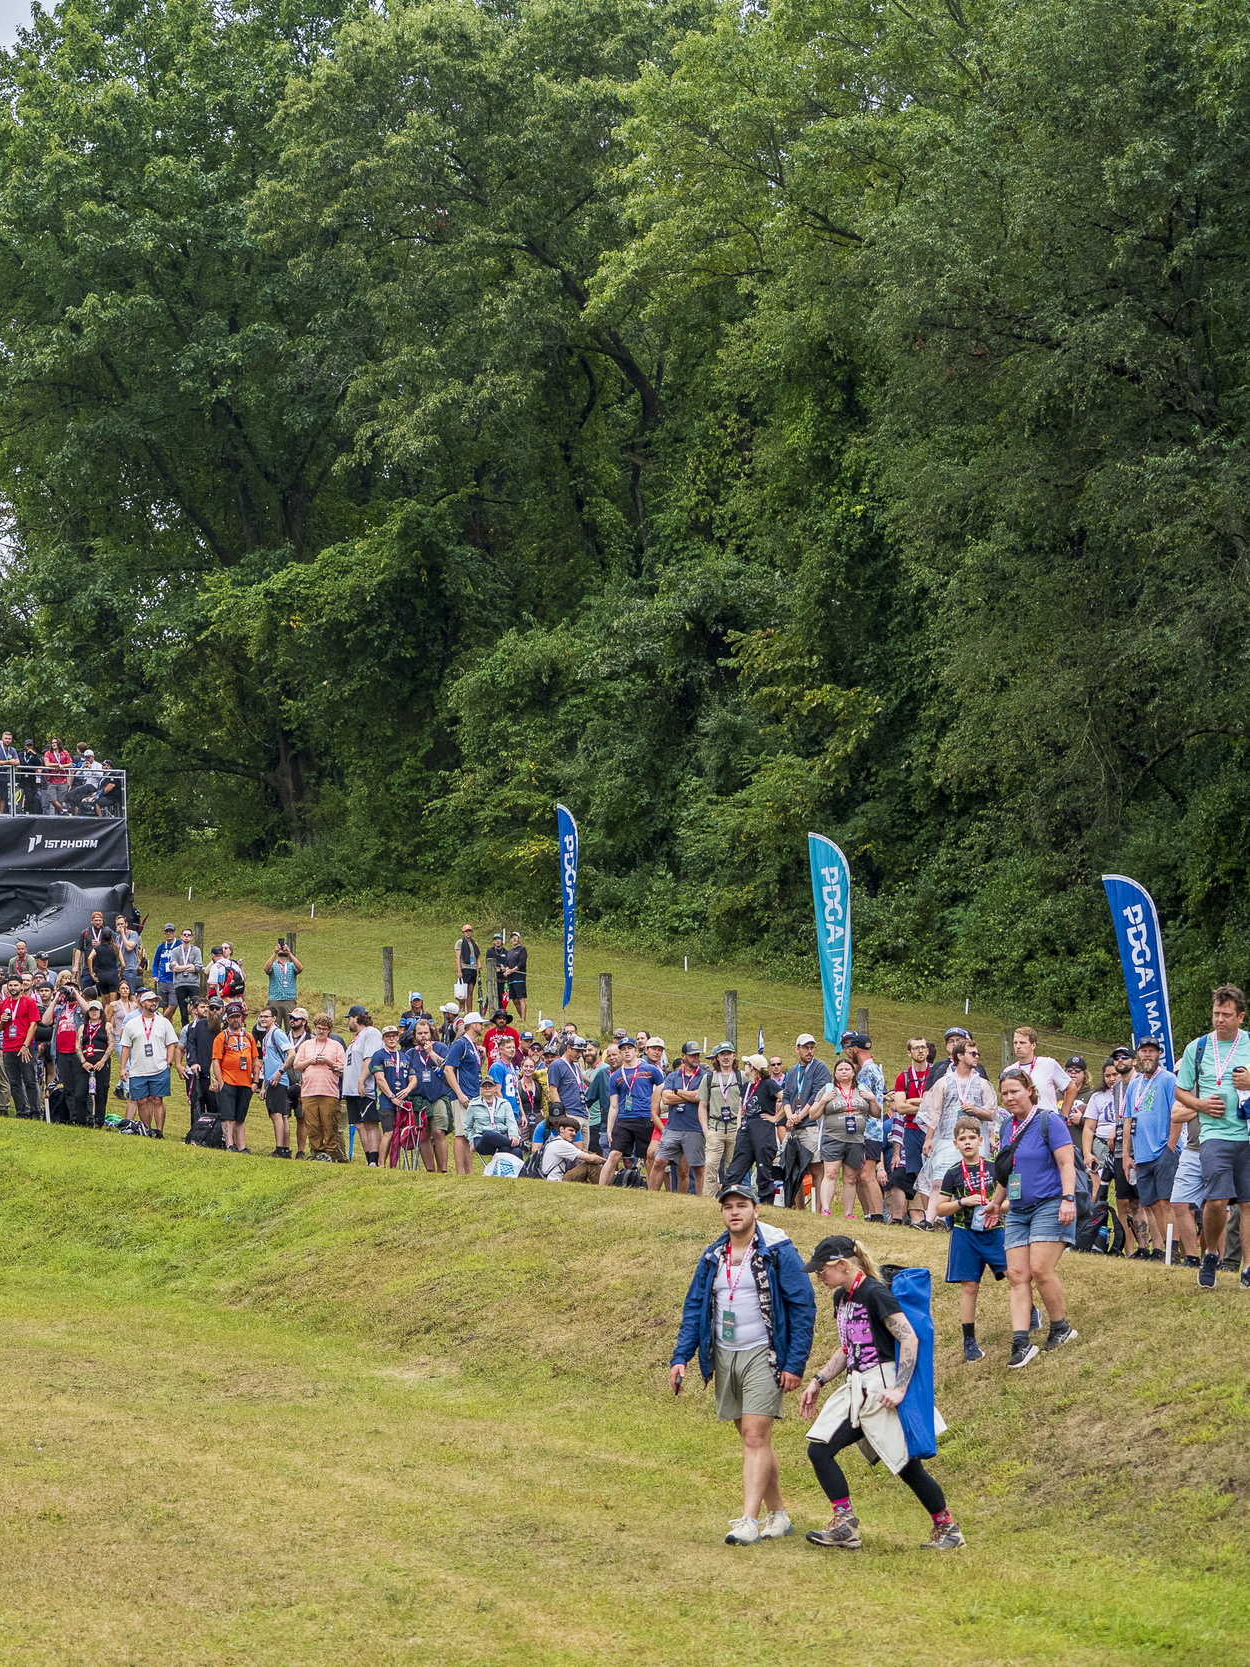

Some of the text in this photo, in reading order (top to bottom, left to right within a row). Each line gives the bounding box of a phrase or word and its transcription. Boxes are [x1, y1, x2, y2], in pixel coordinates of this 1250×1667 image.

[564, 834, 577, 906] PDGA
[820, 866, 845, 945] PDGA
[1122, 903, 1155, 990] PDGA
